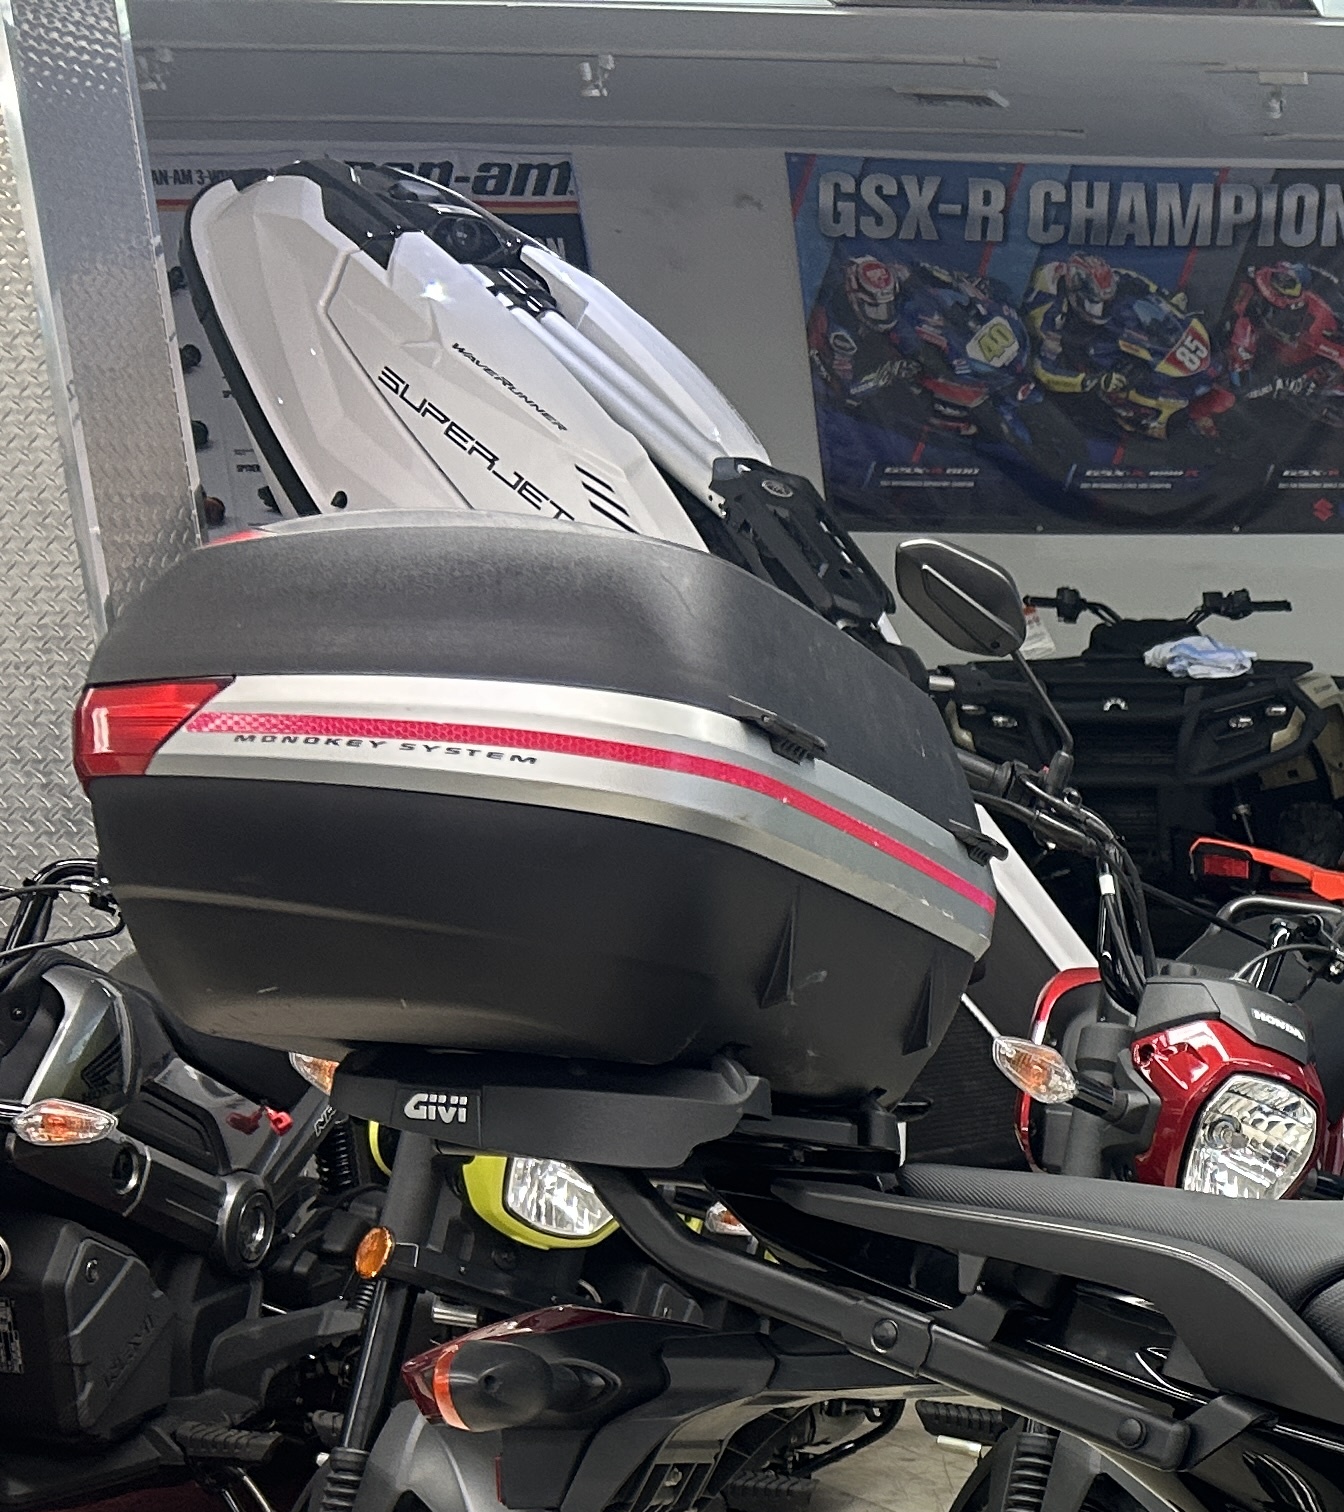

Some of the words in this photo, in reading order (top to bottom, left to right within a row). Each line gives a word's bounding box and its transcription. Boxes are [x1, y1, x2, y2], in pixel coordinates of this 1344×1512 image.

[151, 168, 193, 186] AN-AM
[345, 160, 573, 197] n-am
[817, 171, 1006, 243] GSX-R
[1175, 334, 1210, 371] 85
[452, 342, 568, 431] WAVERUNNER
[378, 365, 575, 520] SUPERJET
[234, 734, 388, 749] MONOKEY
[398, 741, 538, 765] SYSTEM
[403, 1092, 468, 1124] GIVI
